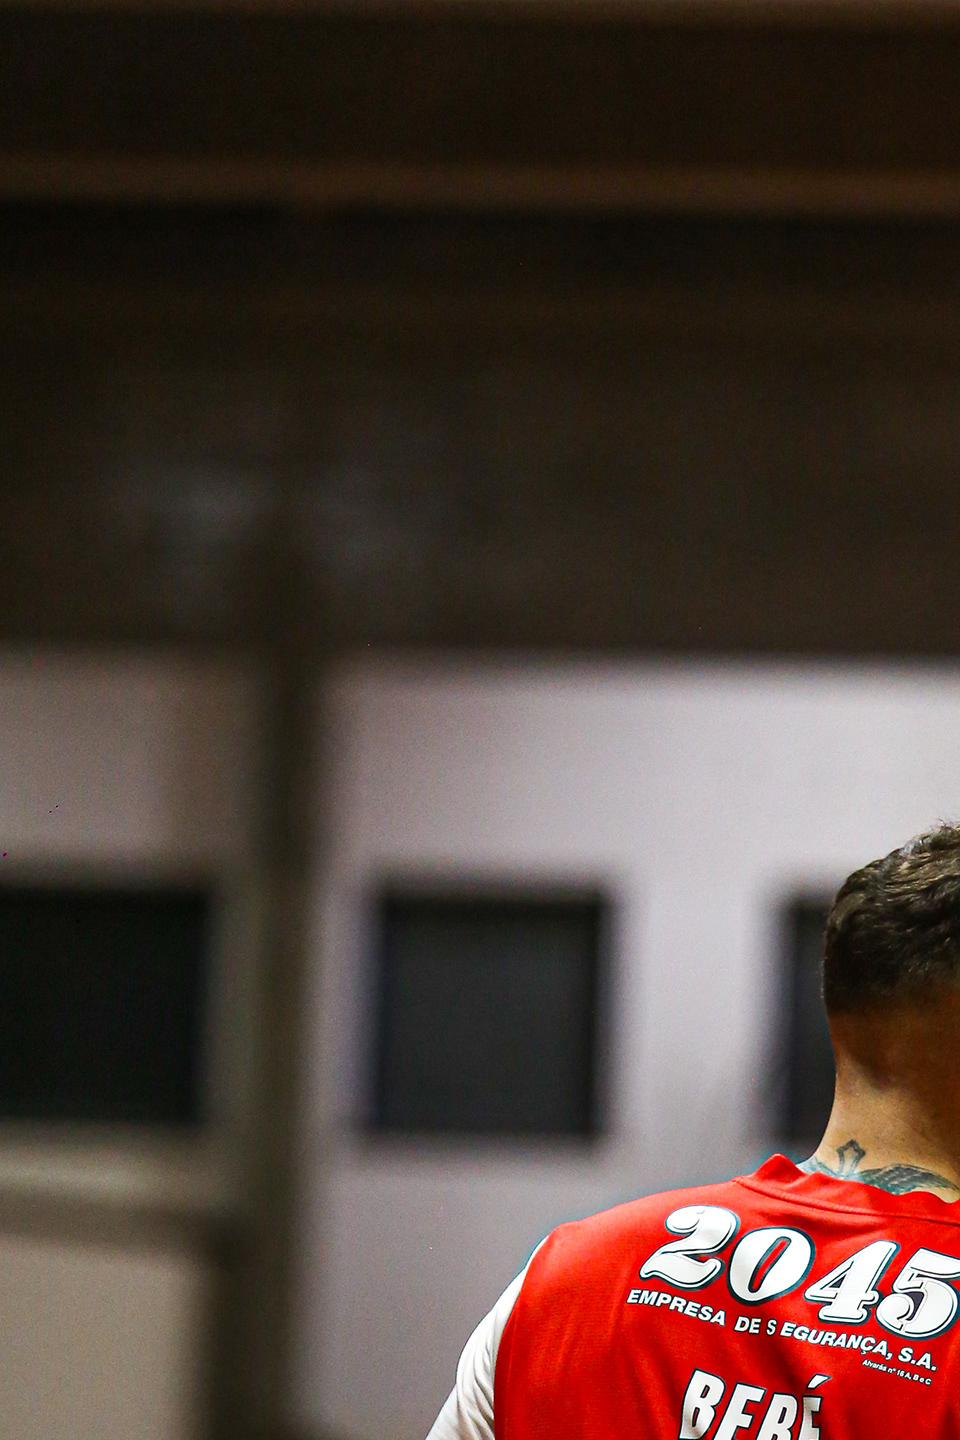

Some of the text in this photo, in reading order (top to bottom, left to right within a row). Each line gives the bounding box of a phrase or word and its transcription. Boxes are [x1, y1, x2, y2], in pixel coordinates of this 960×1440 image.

[626, 1289, 726, 1326] EMPRESA
[734, 1316, 761, 1334] DE
[898, 1347, 937, 1371] S.A.
